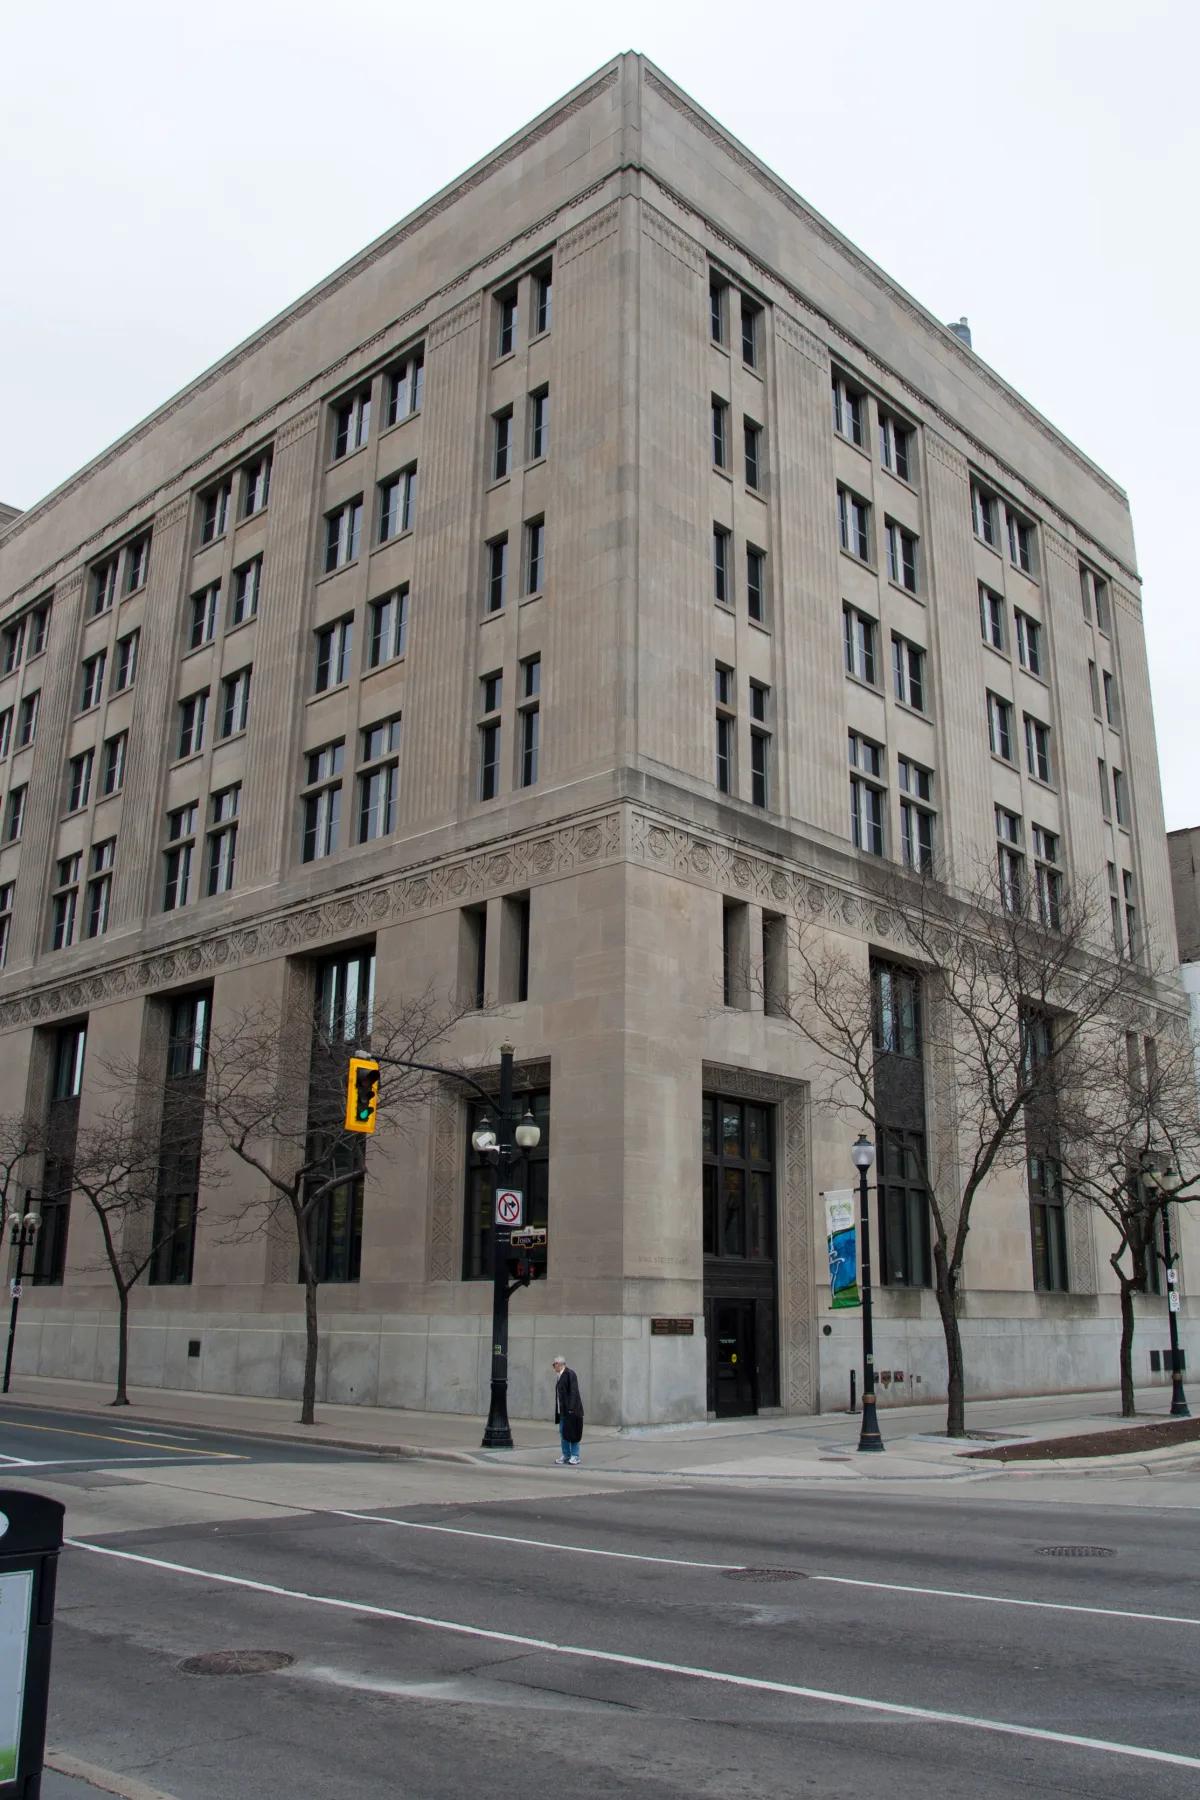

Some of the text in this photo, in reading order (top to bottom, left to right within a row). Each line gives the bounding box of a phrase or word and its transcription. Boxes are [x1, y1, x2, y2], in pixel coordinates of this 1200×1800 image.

[517, 1236, 531, 1244] JOHN
[537, 1235, 541, 1243] S
[654, 1256, 674, 1265] STREET
